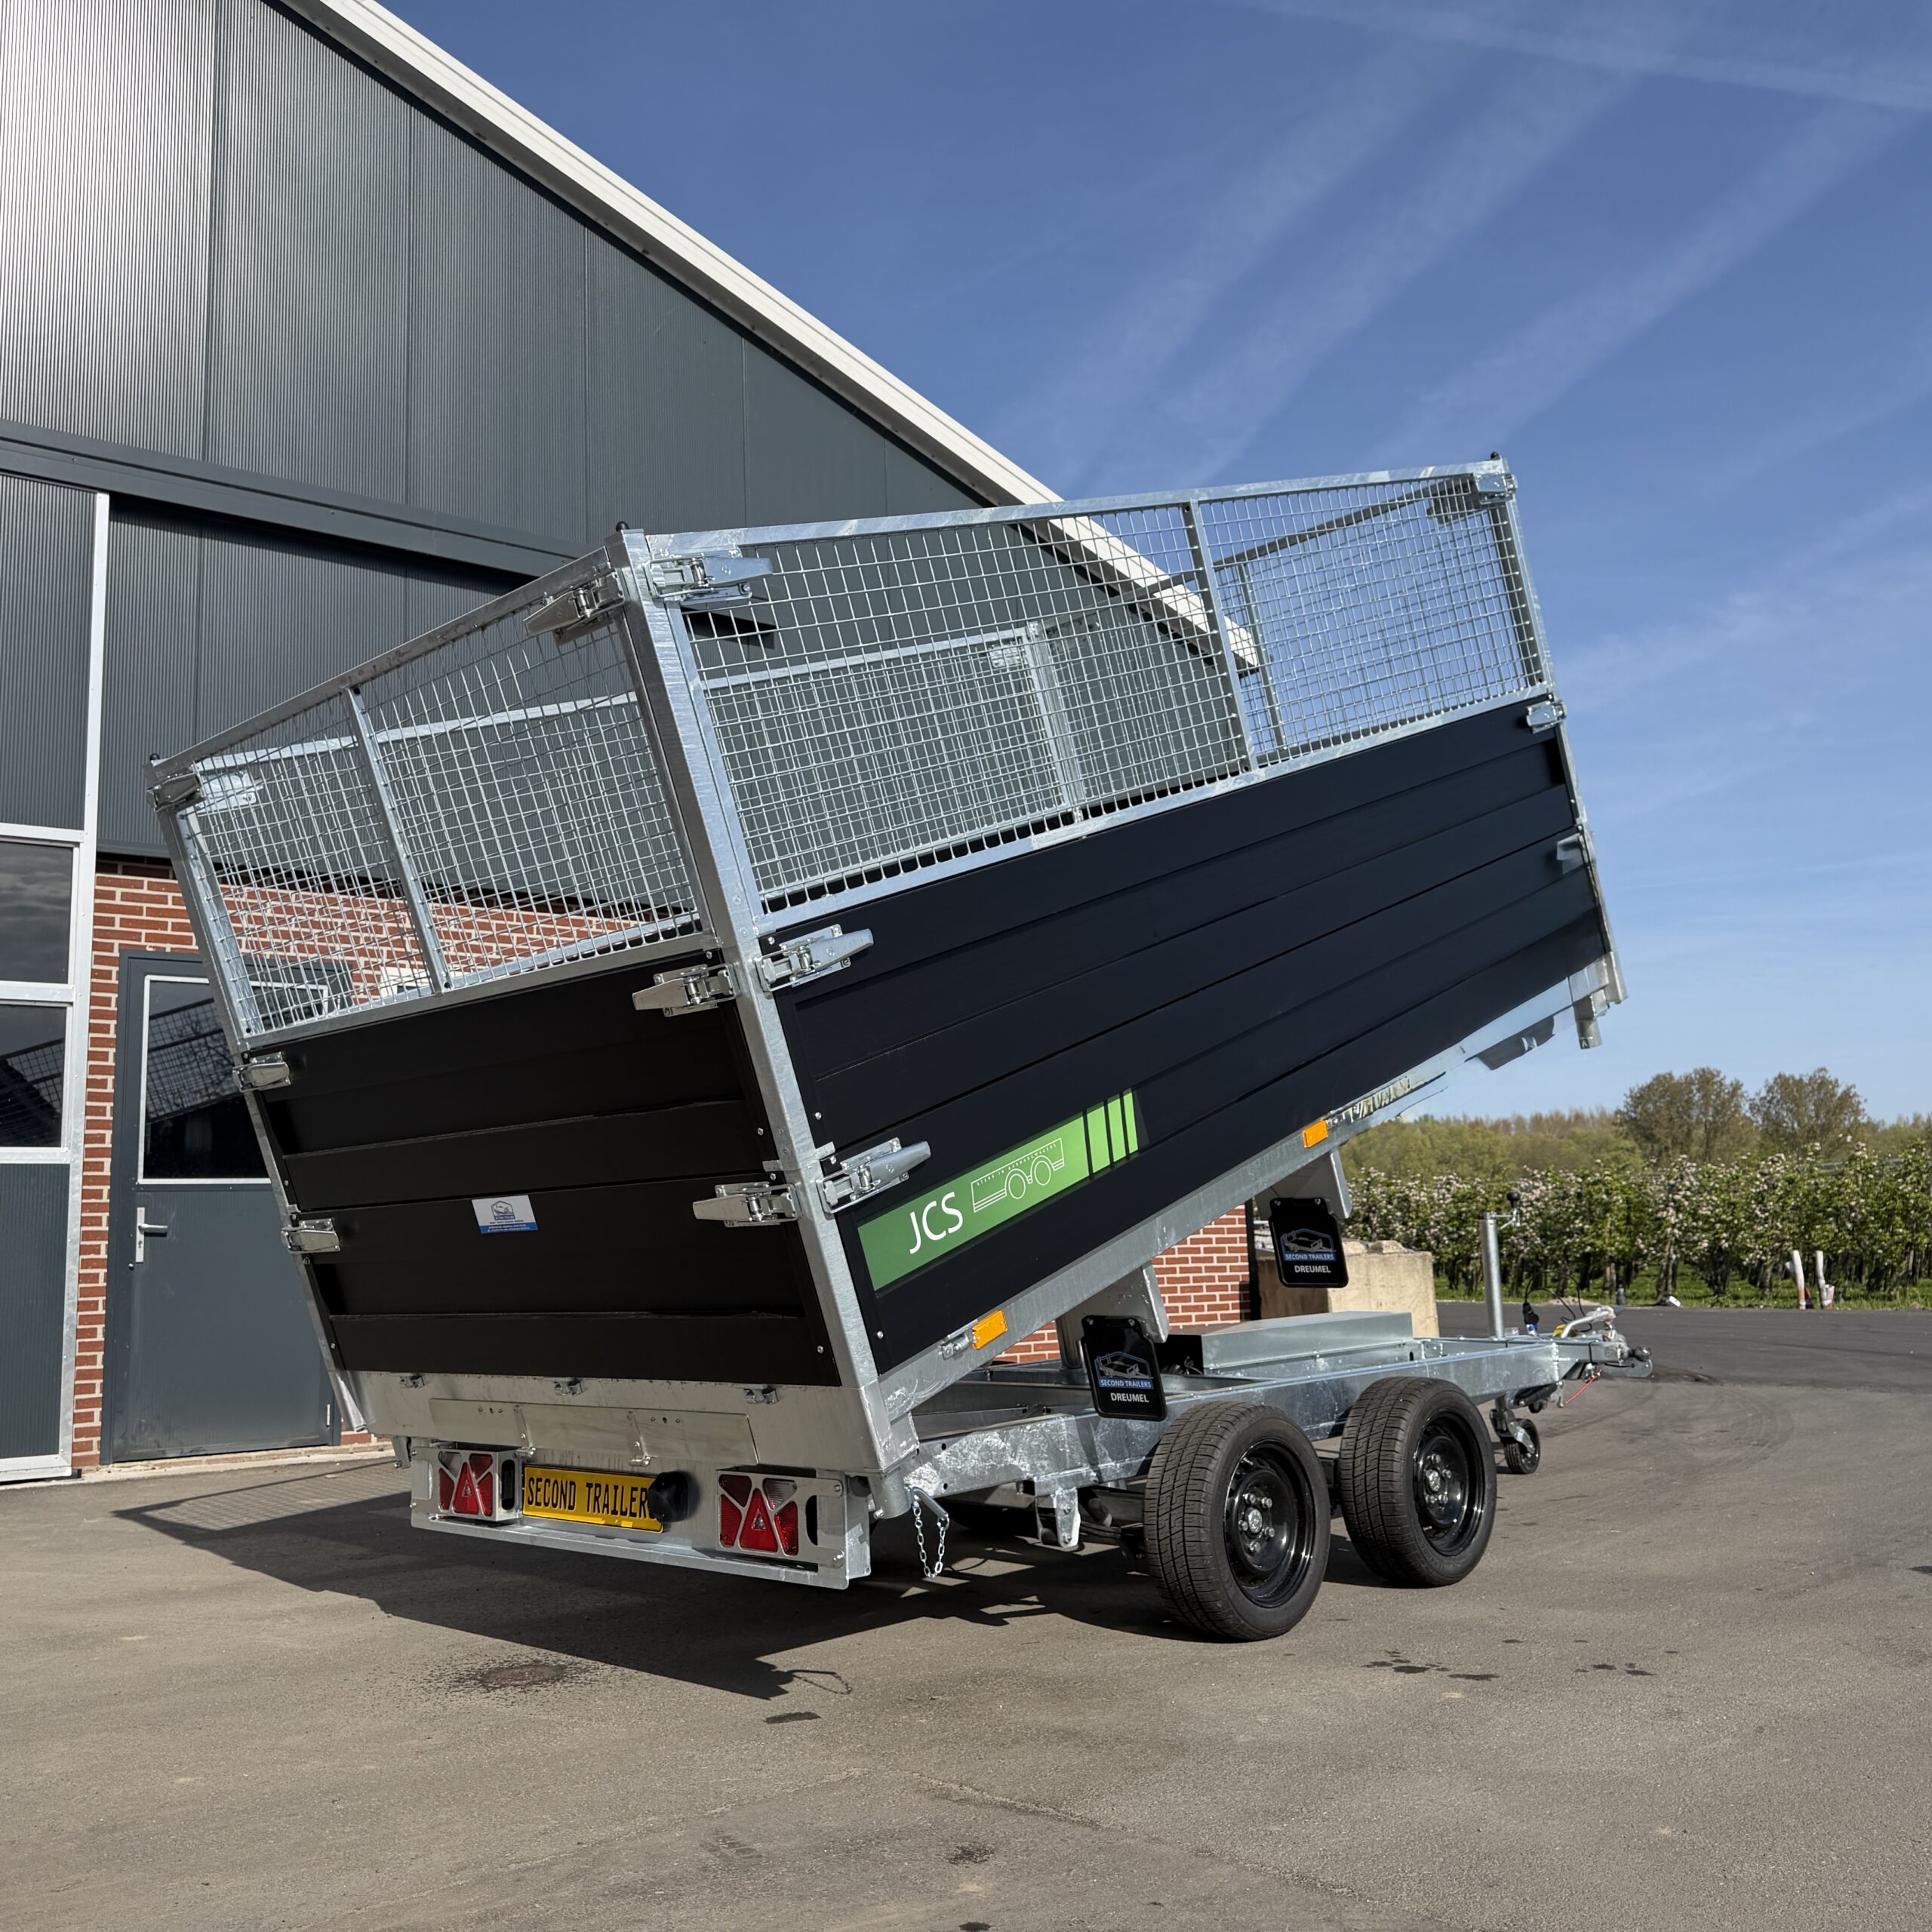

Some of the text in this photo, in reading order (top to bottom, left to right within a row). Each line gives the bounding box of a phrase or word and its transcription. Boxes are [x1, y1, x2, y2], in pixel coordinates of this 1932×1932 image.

[909, 1192, 963, 1254] JCS
[1294, 1265, 1332, 1273] DREUMEL
[1110, 1392, 1149, 1402] DREUMEL
[528, 1477, 656, 1519] SECOND TRAILER
